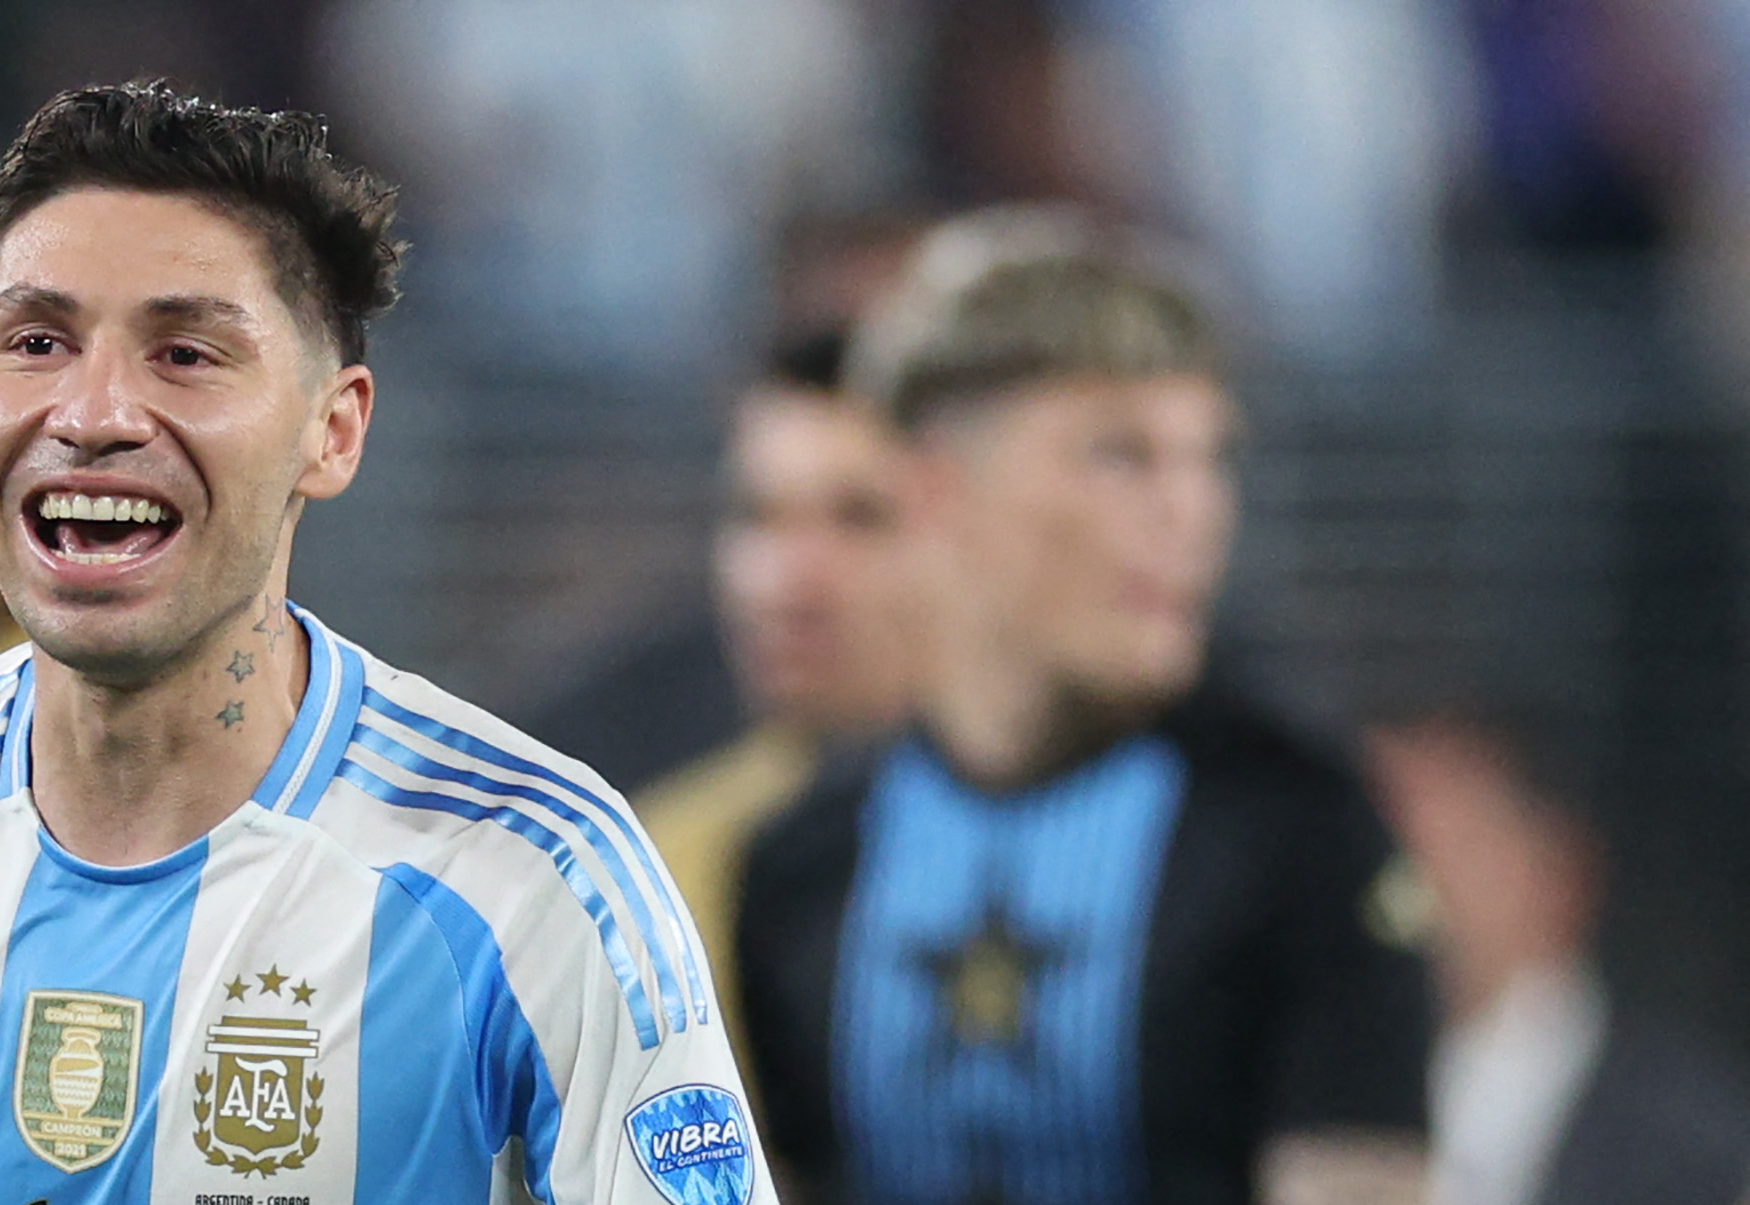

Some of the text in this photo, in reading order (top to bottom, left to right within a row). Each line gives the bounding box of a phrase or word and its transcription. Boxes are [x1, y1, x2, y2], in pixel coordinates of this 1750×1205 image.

[220, 1056, 296, 1133] AFA
[653, 1118, 740, 1159] VIBRA
[658, 1146, 744, 1172] EL CONTINENTE
